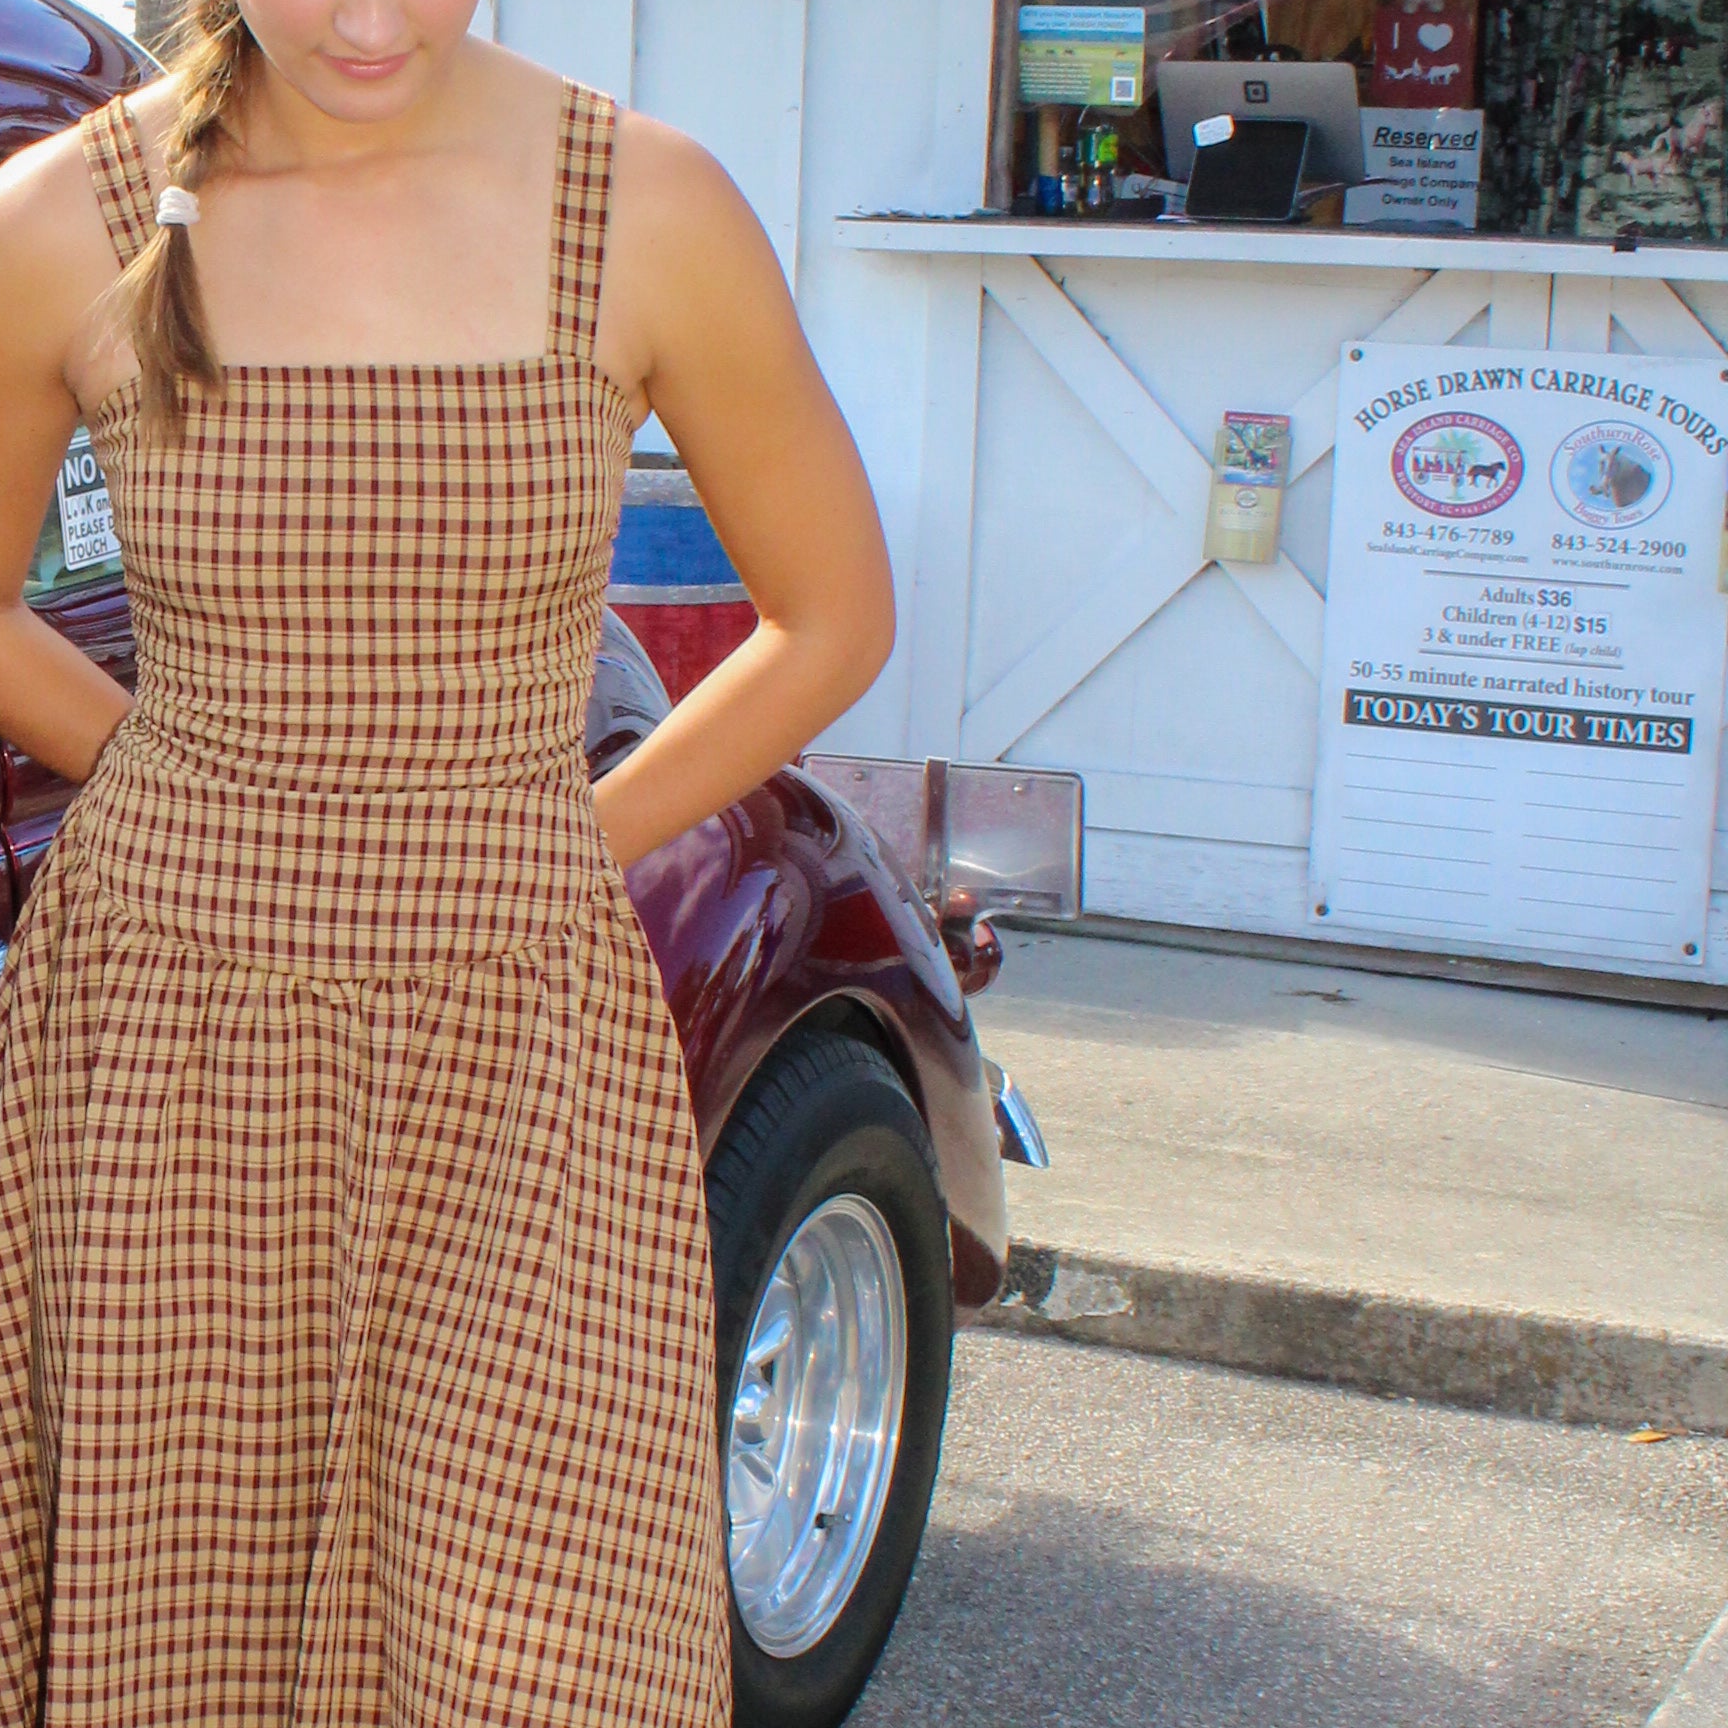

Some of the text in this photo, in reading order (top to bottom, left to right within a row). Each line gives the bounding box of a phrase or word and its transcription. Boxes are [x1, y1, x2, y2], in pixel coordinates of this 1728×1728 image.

[1373, 126, 1478, 150] Reserved
[1390, 156, 1456, 170] Sea Island
[1381, 193, 1458, 210] Owner Only
[1354, 367, 1728, 456] HORSE DRAWN CARRIAGE TOURS
[68, 517, 105, 540] PLEASE
[1382, 521, 1514, 546] 843-476-7789
[70, 536, 108, 561] TOUCH
[1551, 533, 1686, 558] 843-524-2900
[1479, 587, 1572, 608] Adults $36
[1442, 606, 1607, 635] Children (4-12) $15
[1423, 628, 1622, 659] 3 & under FREE (lap child)
[1349, 660, 1696, 708] 50-55 minute narrated history tour
[1487, 707, 1577, 740] TOUR
[1584, 715, 1687, 749] TIMES
